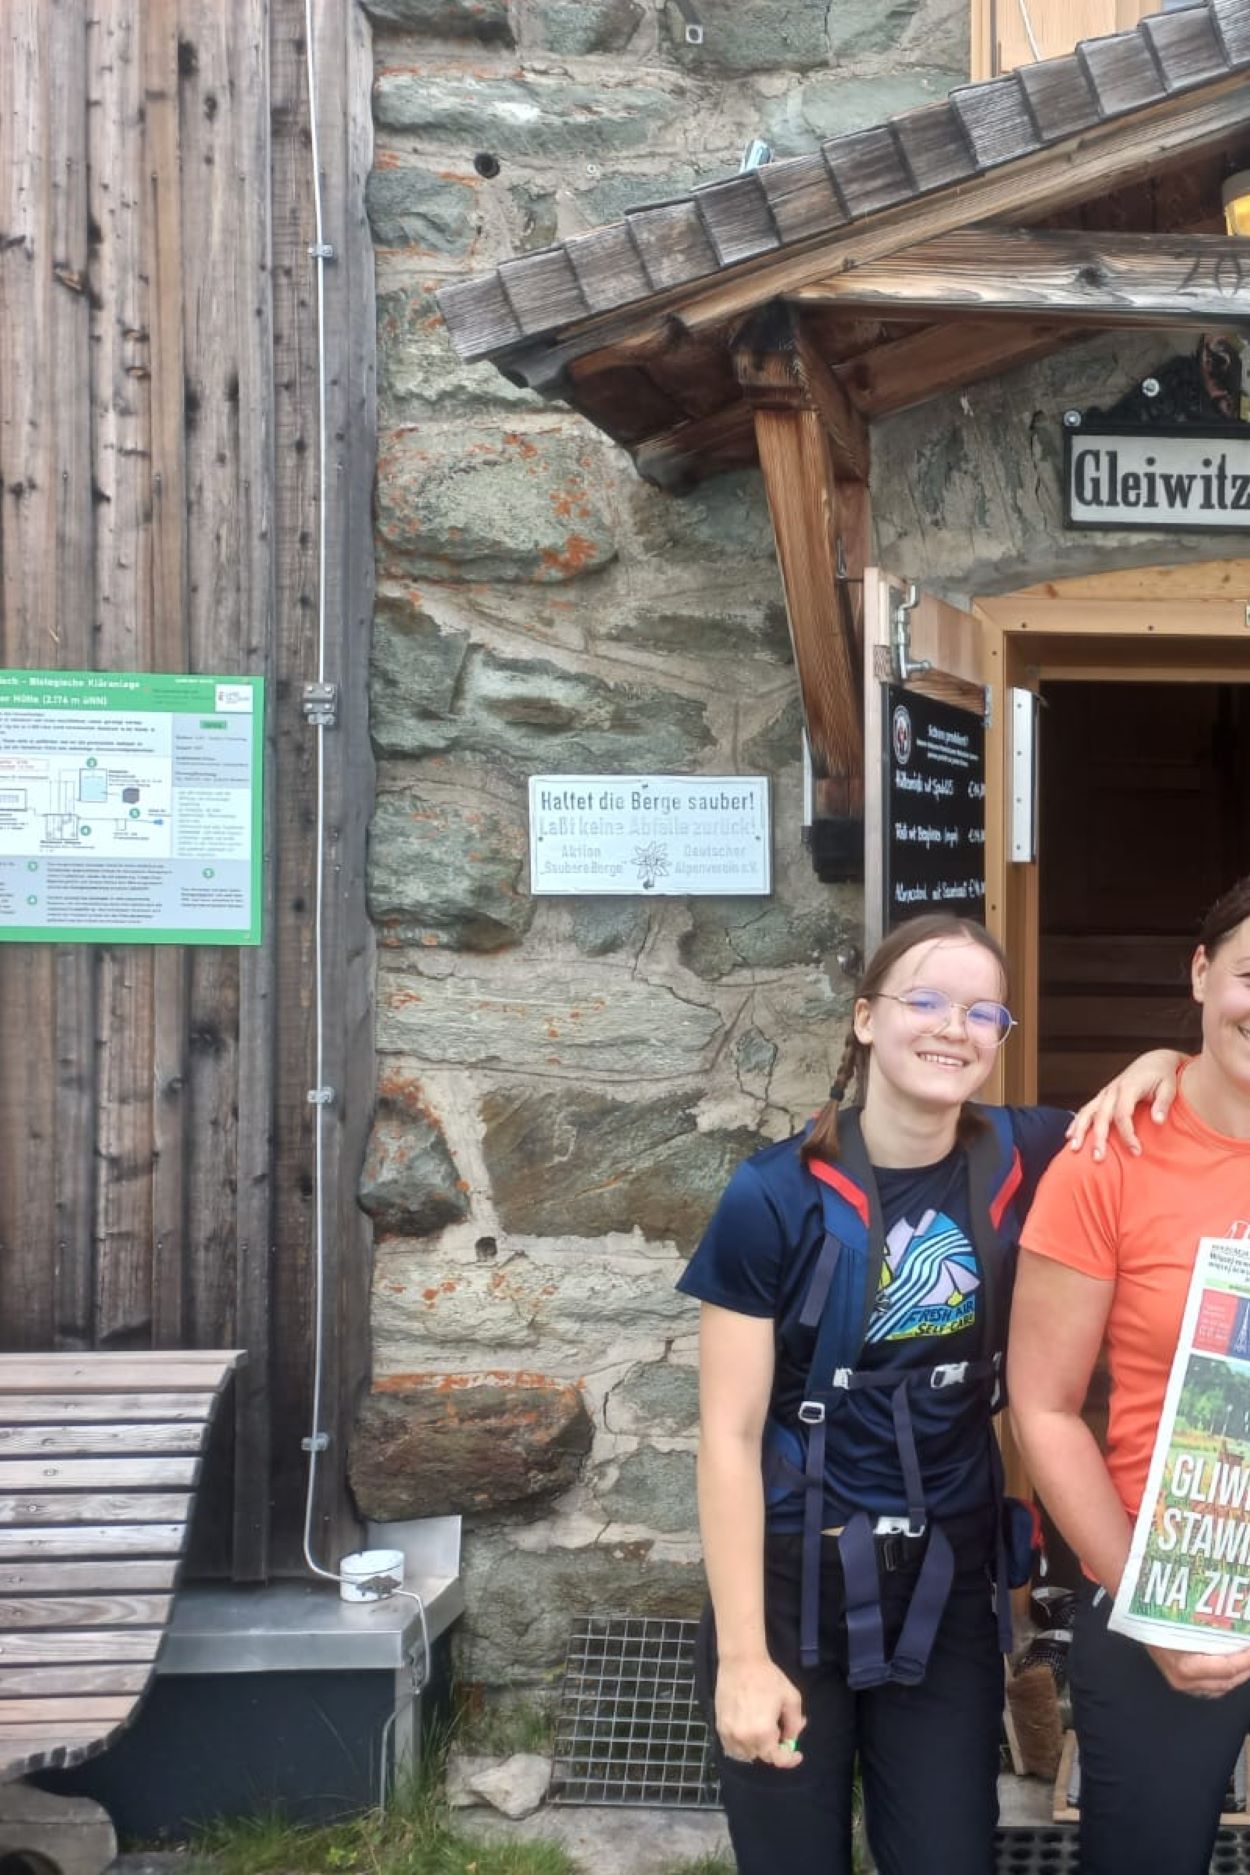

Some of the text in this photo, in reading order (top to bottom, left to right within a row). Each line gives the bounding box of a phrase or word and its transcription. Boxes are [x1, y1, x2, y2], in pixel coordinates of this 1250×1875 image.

[28, 677, 84, 688] Biologische
[88, 678, 140, 691] Kläranlage
[541, 791, 755, 815] Haltet die Berge sauber!
[911, 1308, 952, 1322] FRESH
[1143, 1563, 1189, 1611] NA
